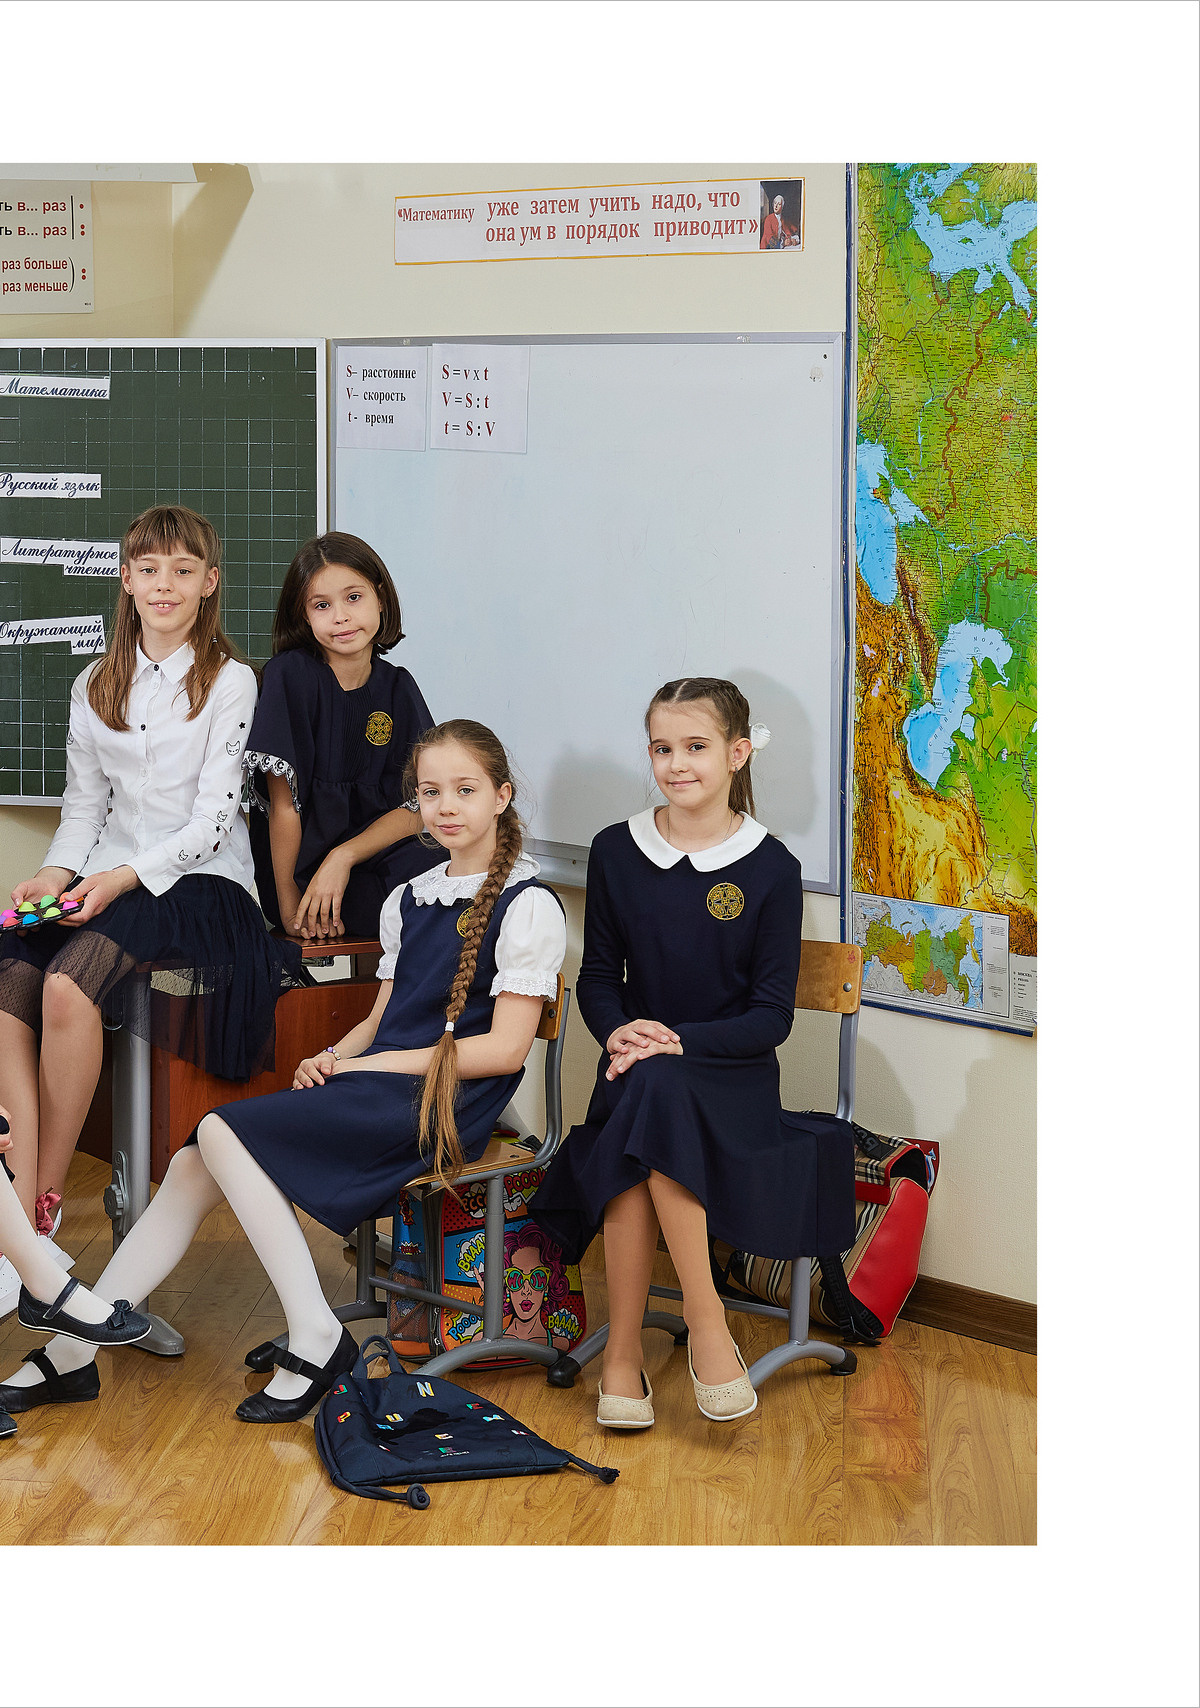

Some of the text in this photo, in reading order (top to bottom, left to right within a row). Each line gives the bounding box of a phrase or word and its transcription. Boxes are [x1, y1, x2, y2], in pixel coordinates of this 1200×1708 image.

[42, 201, 67, 216] раз
[487, 198, 520, 220] уже
[530, 198, 580, 215] затем
[589, 195, 641, 218] учить
[651, 191, 702, 211] надо,
[708, 190, 740, 207] что
[43, 226, 67, 240] раз
[486, 217, 758, 245] она ум в порядок приводит»
[2, 259, 21, 275] раз
[24, 257, 68, 271] больше
[2, 281, 22, 296] раз
[24, 281, 68, 293] меньше
[362, 367, 417, 381] расстояние
[0, 377, 108, 398] Математика
[363, 391, 406, 404] скорость
[365, 413, 394, 427] время
[61, 482, 100, 497] язык
[2, 538, 118, 564] Литературное
[64, 565, 118, 576] чтение
[72, 638, 105, 654] мир
[458, 1236, 485, 1272] BAAA
[448, 1314, 483, 1341] POOO
[548, 1315, 584, 1340] BAAAM!
